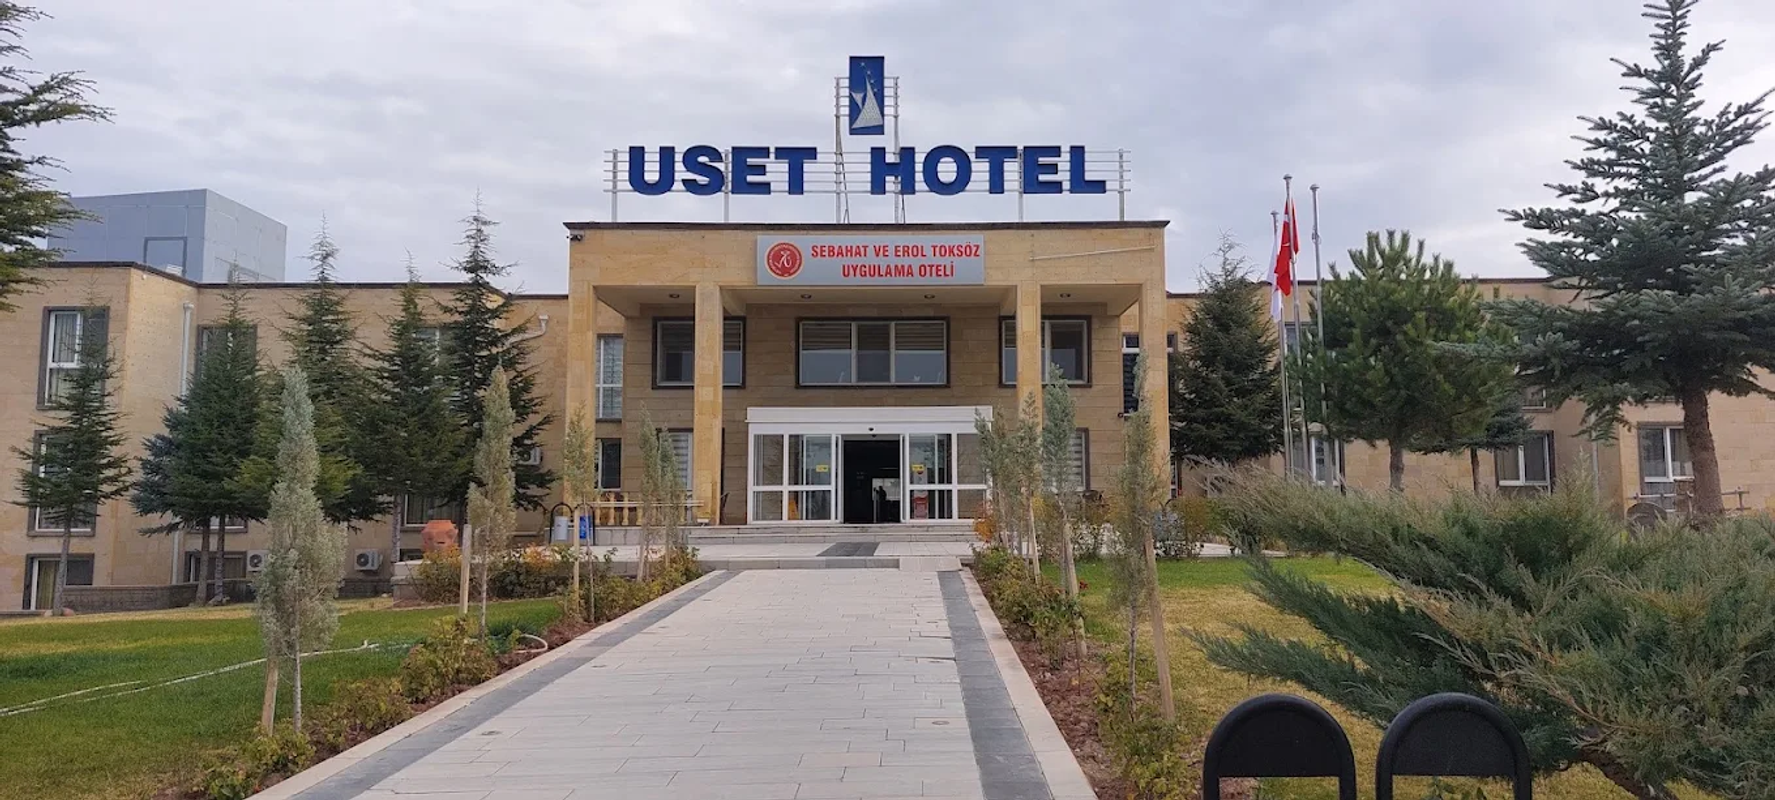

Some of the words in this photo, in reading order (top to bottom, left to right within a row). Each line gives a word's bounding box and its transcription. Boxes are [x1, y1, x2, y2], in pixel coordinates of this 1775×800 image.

[628, 145, 818, 195] USET
[870, 145, 1106, 195] HOTEL
[811, 244, 869, 259] SEBAHAT
[873, 244, 890, 258] VE
[894, 244, 928, 259] EROL
[931, 241, 981, 258] TOKSÖZ
[841, 263, 915, 279] UYGULAMA
[918, 260, 956, 279] OTELİ
